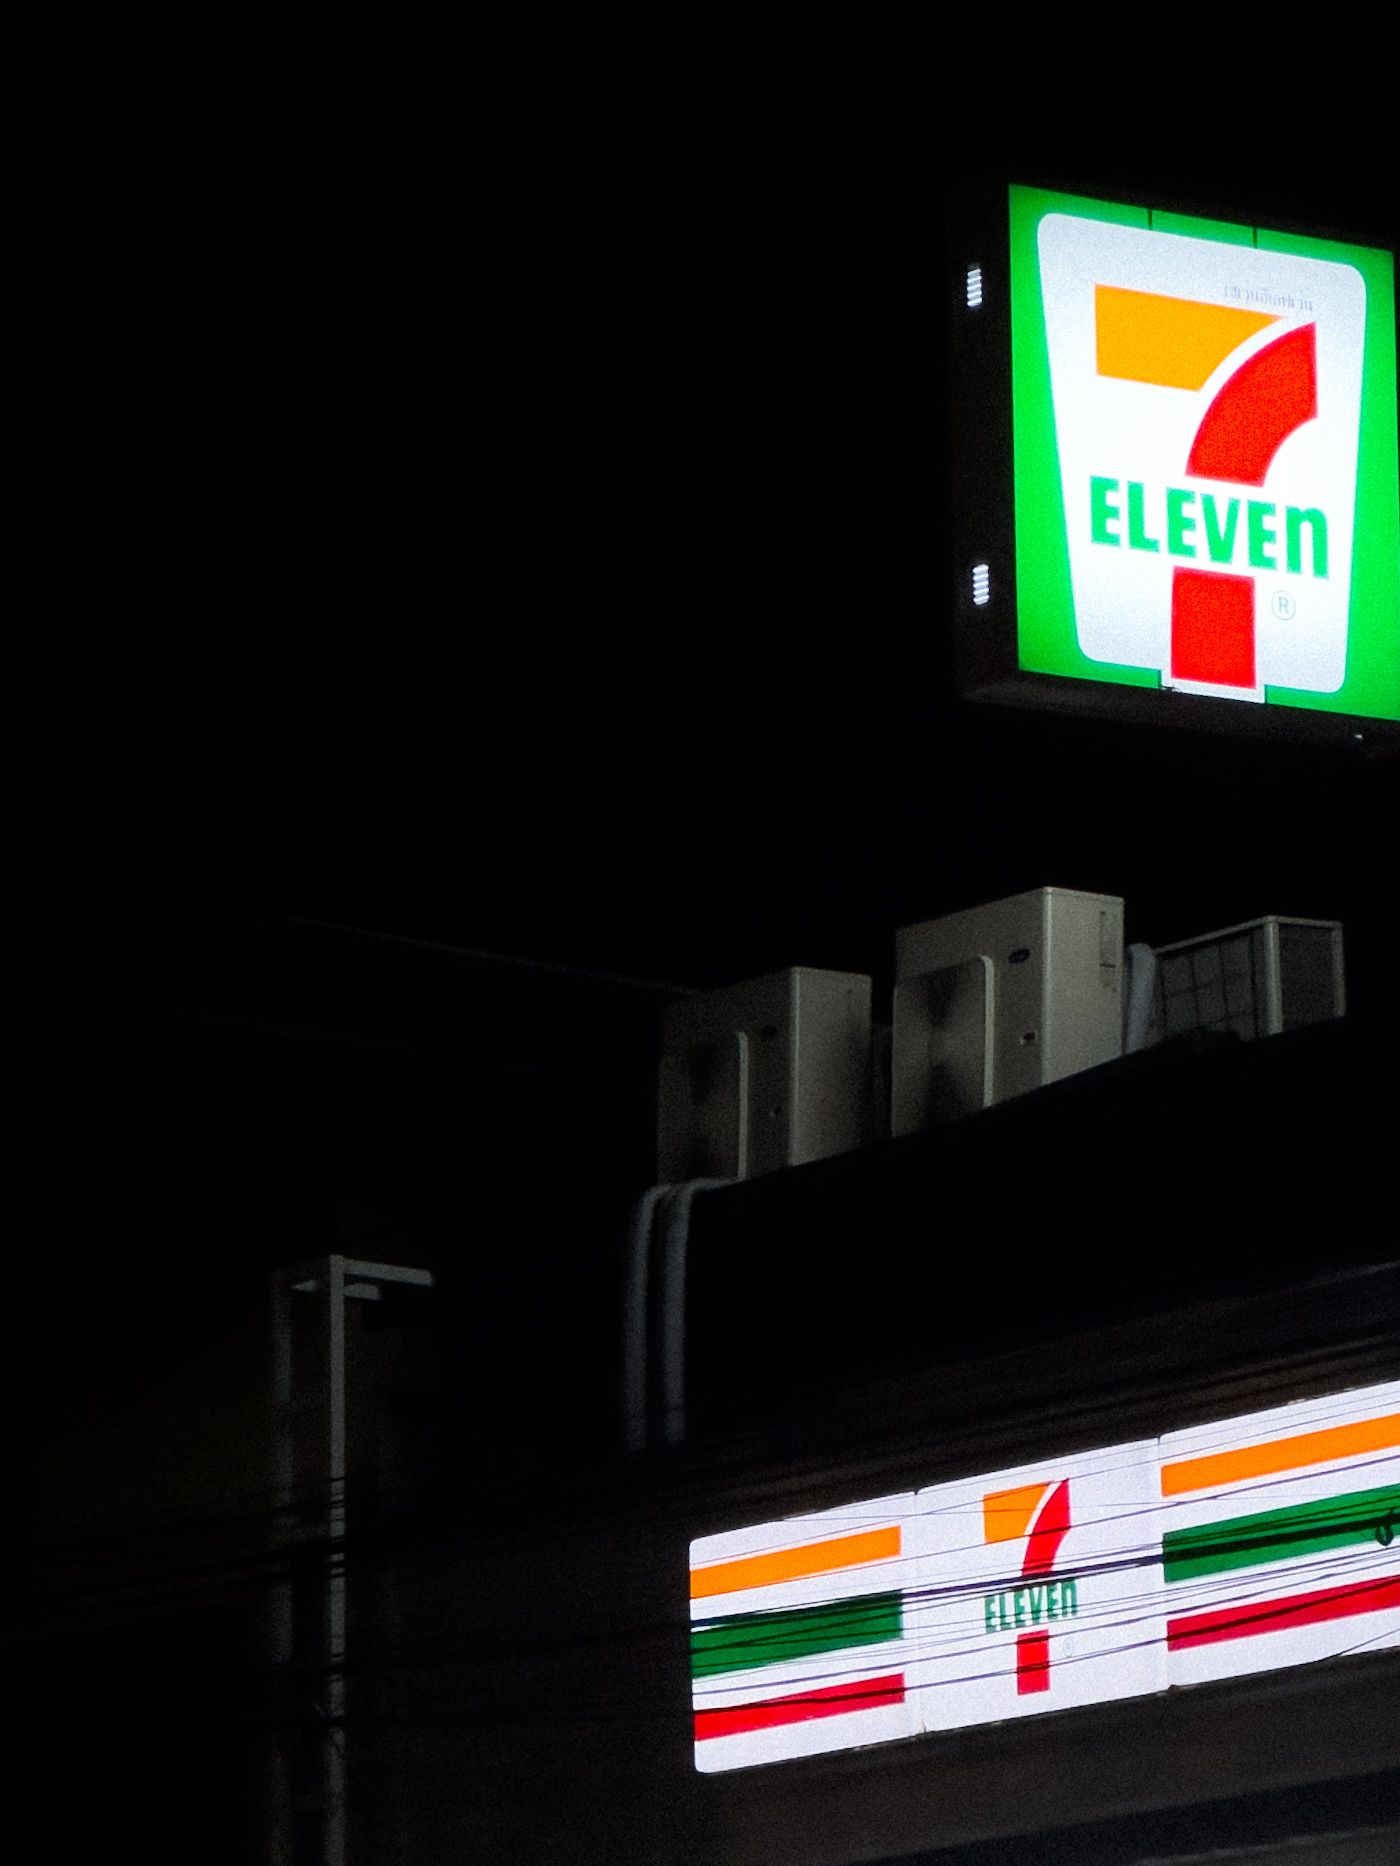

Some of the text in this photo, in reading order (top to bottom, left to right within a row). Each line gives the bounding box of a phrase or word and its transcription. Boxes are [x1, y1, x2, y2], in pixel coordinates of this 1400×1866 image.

[1089, 474, 1329, 580] ELEVEn
[1094, 283, 1318, 689] 7
[982, 1478, 1070, 1695] 7
